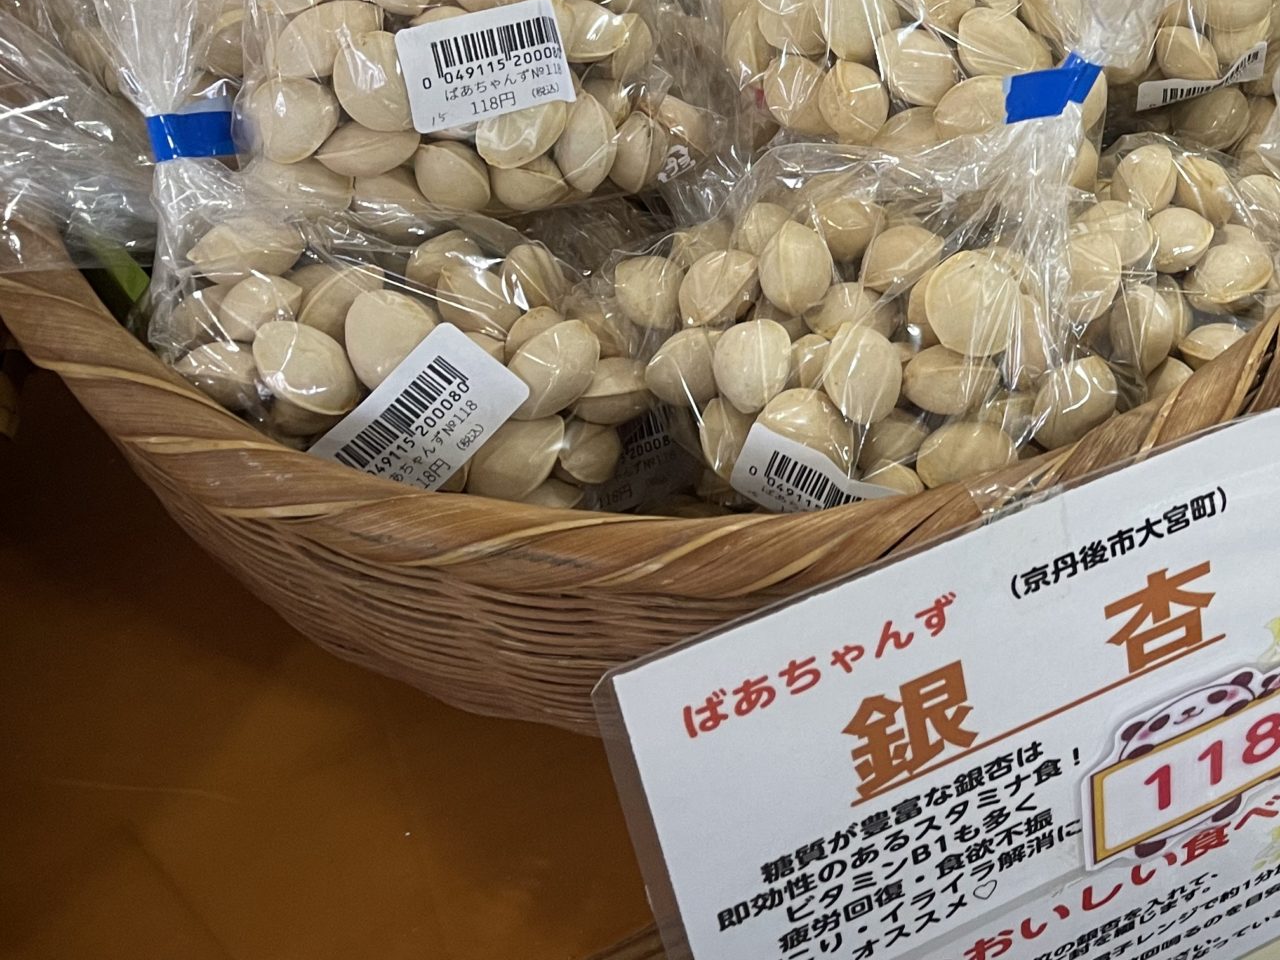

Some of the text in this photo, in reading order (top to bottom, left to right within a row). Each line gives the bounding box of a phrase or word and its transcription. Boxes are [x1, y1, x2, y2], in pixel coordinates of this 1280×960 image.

[443, 58, 506, 85] 049115
[471, 90, 517, 116] 118円
[415, 380, 471, 437] 200080
[683, 592, 957, 739] ばあちゃんず
[761, 740, 1044, 883] 糖質が豊富な銀杏は
